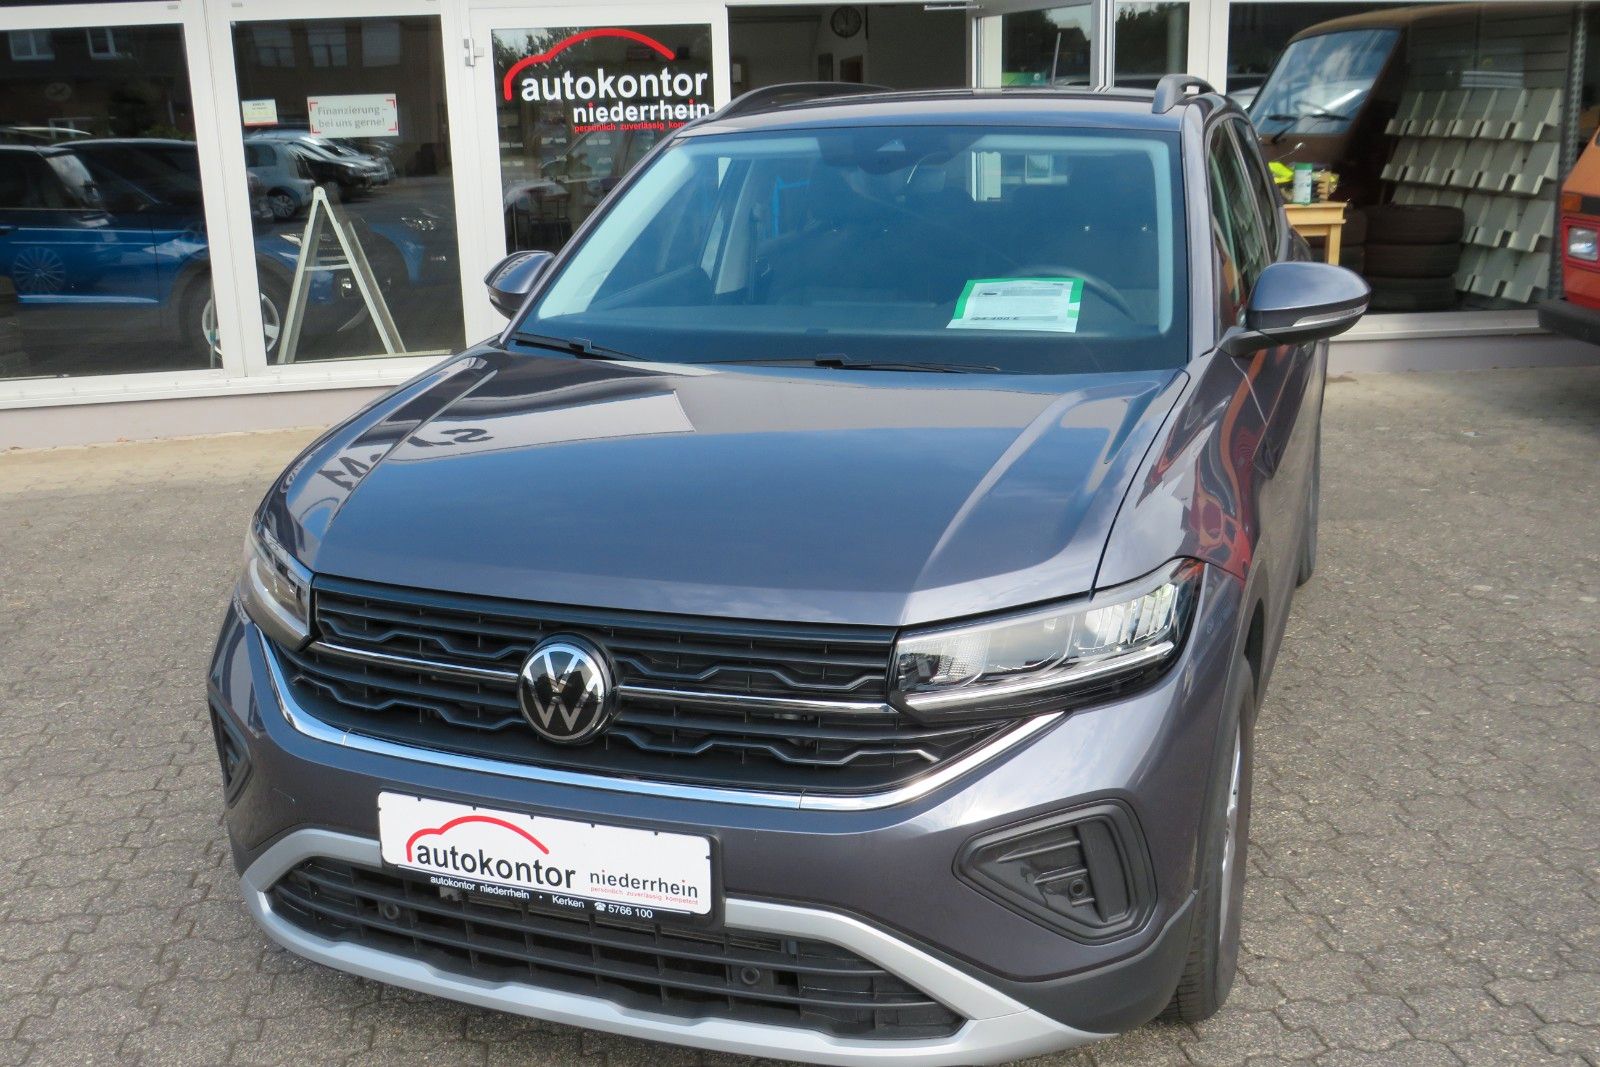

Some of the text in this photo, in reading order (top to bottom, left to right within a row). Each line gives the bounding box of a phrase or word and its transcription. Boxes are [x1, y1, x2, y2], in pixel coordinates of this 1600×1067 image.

[521, 66, 708, 102] autokontor
[317, 104, 380, 116] Finanzierung
[318, 117, 386, 129] bei uns gerne!
[573, 98, 710, 123] niederrhein
[416, 844, 699, 899] autokontor niederrhein
[430, 875, 654, 920] autokontor niederrhein Kerken 5766 100
